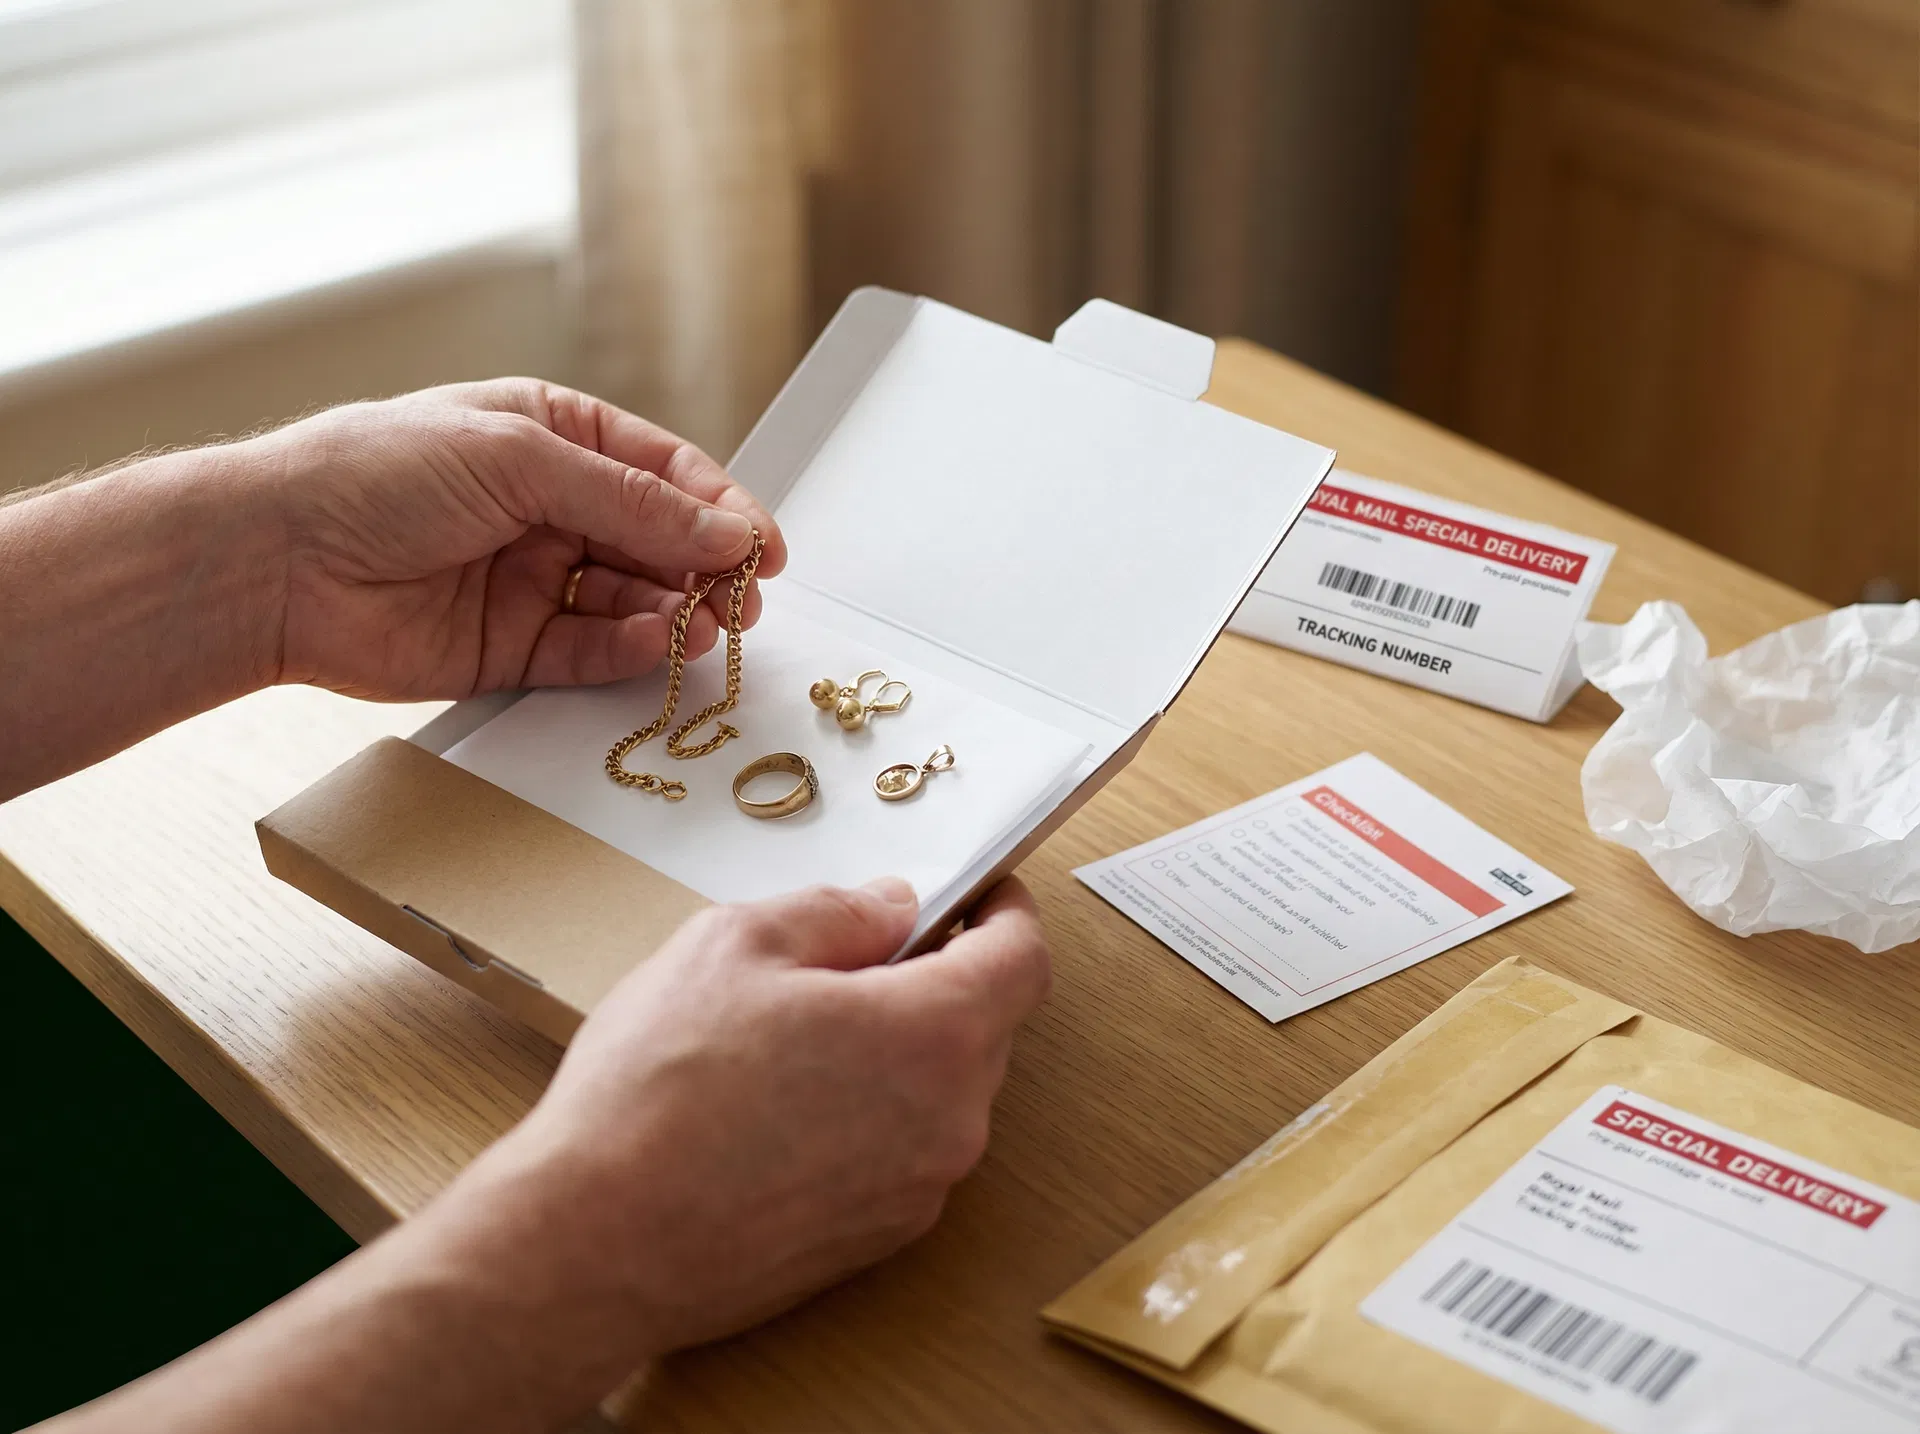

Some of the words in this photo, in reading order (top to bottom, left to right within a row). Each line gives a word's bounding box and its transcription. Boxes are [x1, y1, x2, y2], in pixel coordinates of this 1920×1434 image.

[1353, 500, 1398, 526] MAIL
[1403, 514, 1479, 549] SPECIAL
[1484, 537, 1579, 576] DELIVERY
[1297, 617, 1377, 653] TRACKING
[1381, 643, 1452, 675] NUMBER
[1314, 791, 1385, 841] Checklist
[1588, 1129, 1645, 1157] Pre-paid
[1606, 1108, 1720, 1166] SPECIAL
[1726, 1154, 1878, 1224] DELIVERY
[1538, 1171, 1583, 1194] Royal
[1587, 1190, 1623, 1209] Mail
